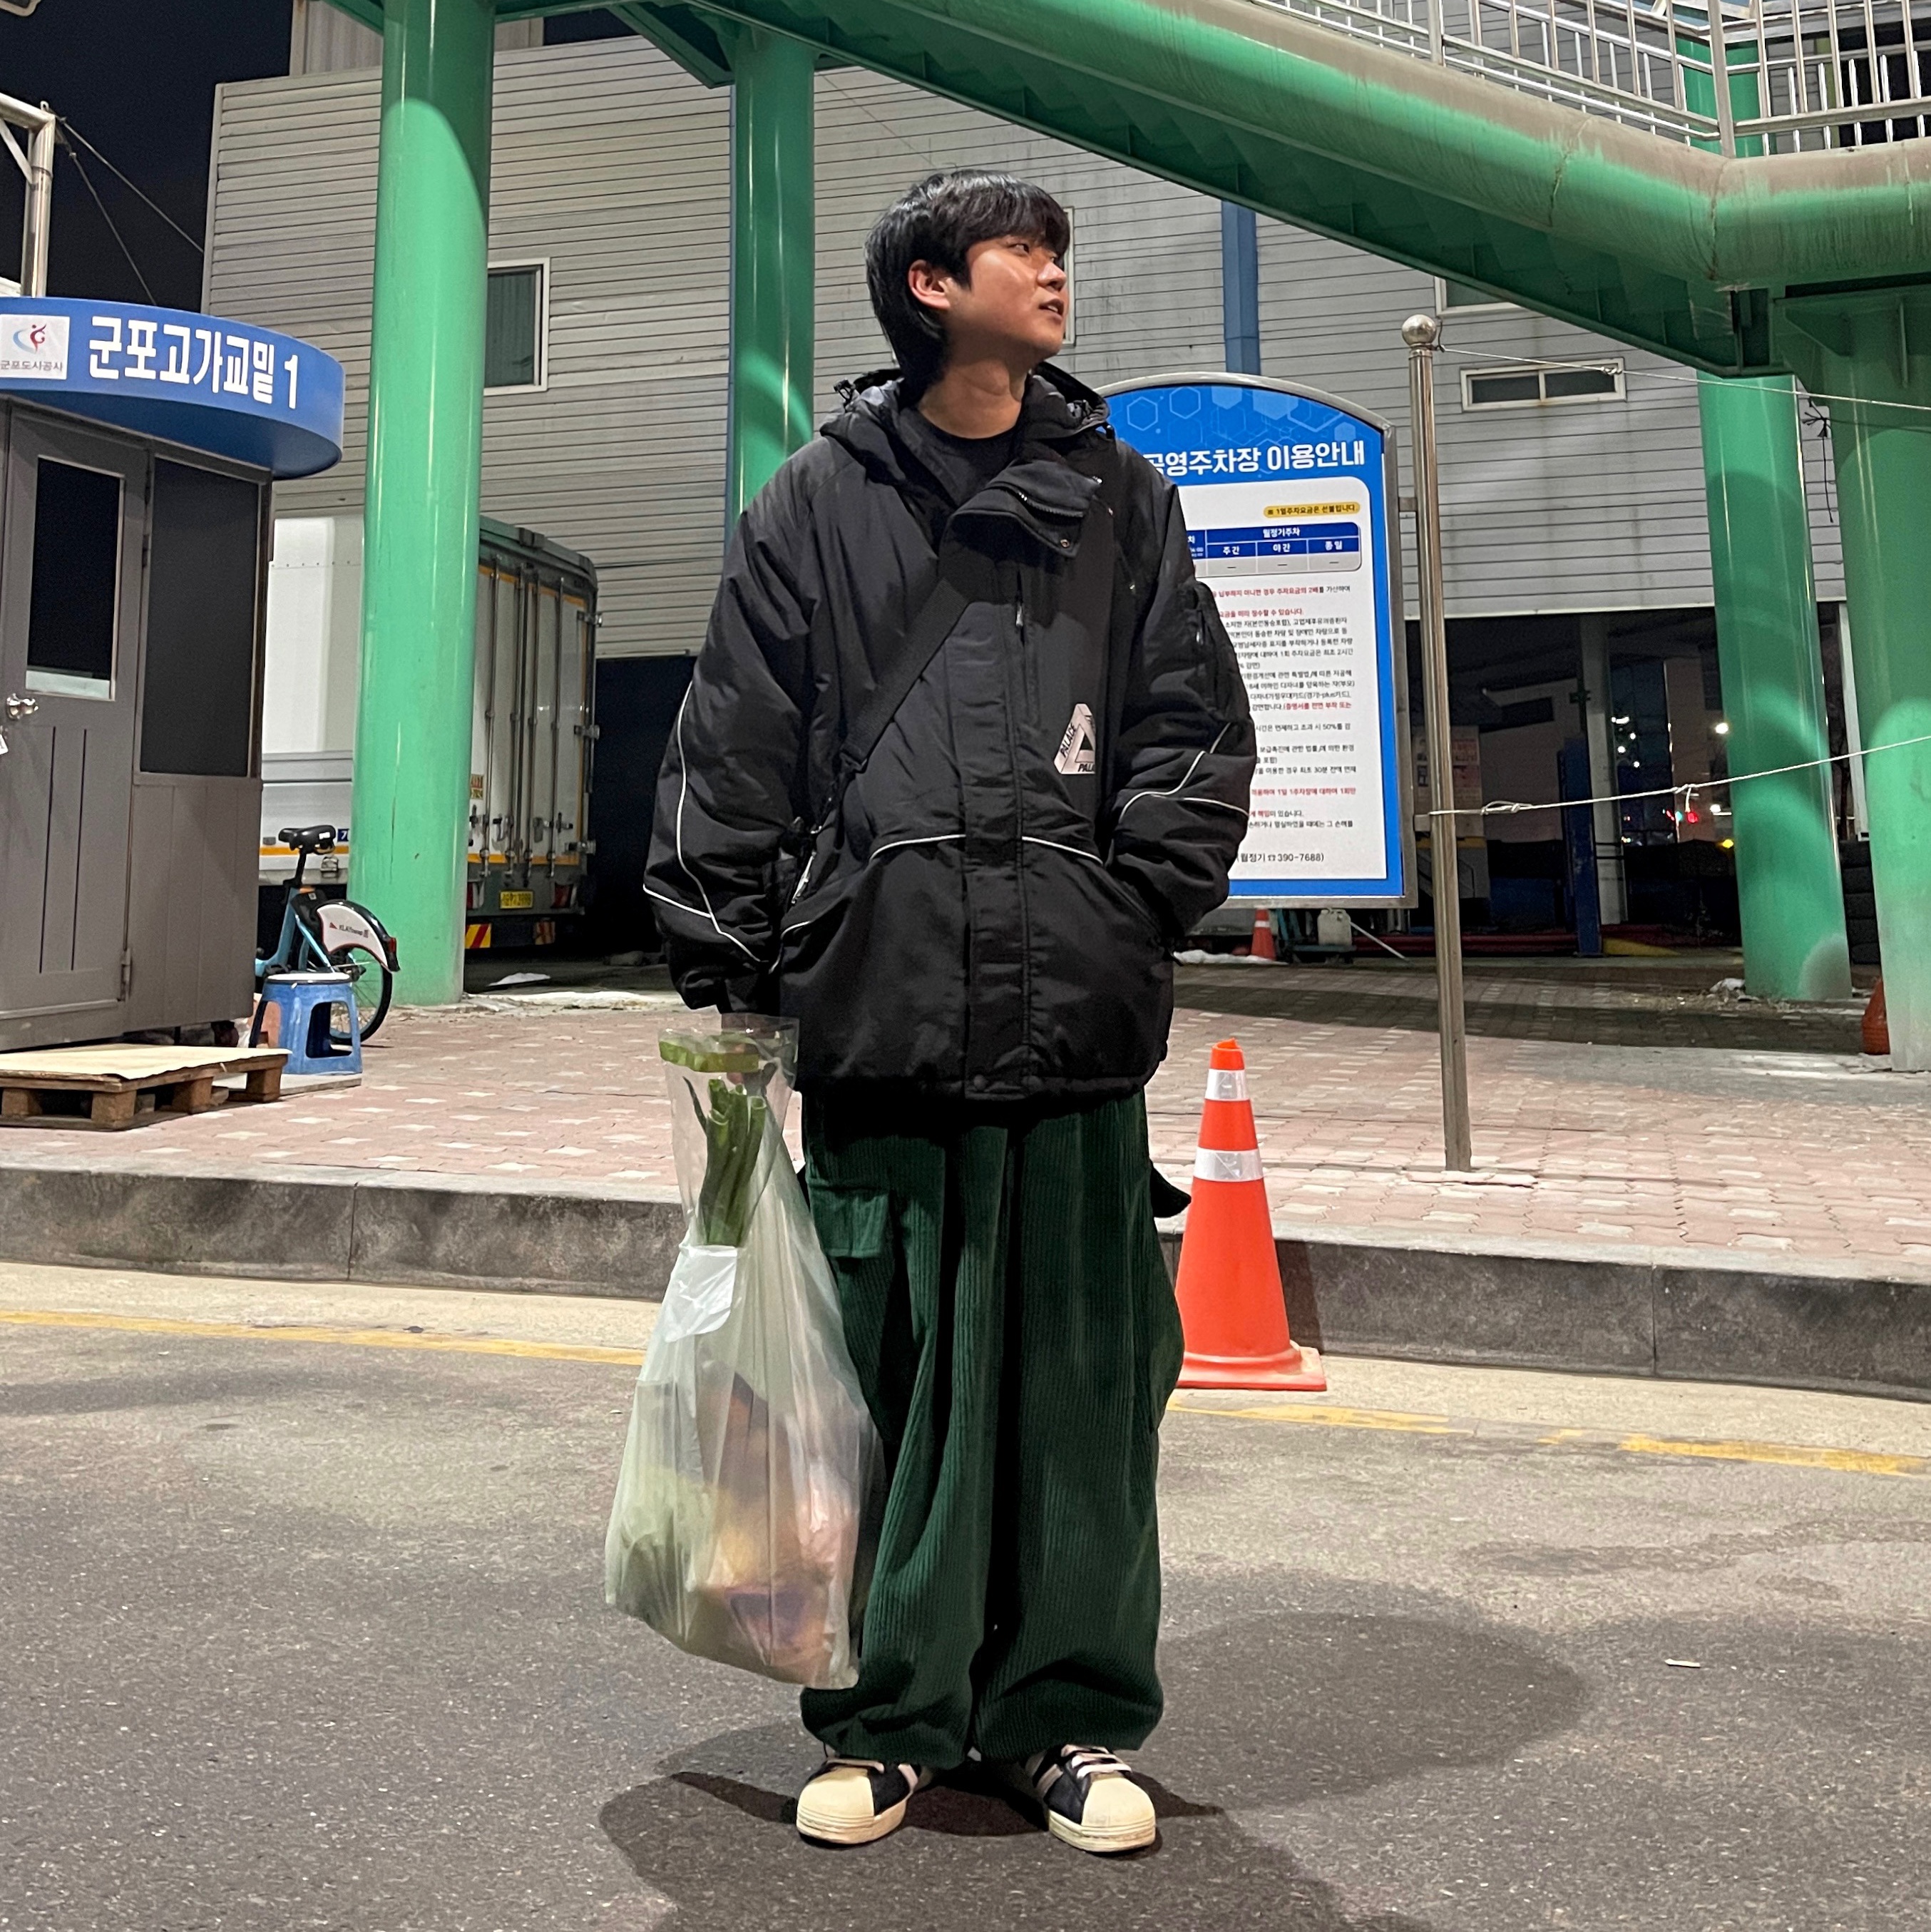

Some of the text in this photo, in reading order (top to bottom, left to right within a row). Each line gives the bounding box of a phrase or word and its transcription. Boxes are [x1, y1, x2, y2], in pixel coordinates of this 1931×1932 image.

[1, 360, 63, 372] 군포도시공사
[89, 316, 298, 409] 군포고가교밑 1
[1267, 440, 1365, 470] 이용안내
[1277, 504, 1355, 514] 1일주차요금은 선불입니다
[1263, 527, 1300, 538] 월정기주차
[1223, 546, 1239, 555] 주간
[1273, 543, 1291, 553] 야간
[1325, 541, 1343, 550] 종일
[1077, 763, 1095, 772] PAL
